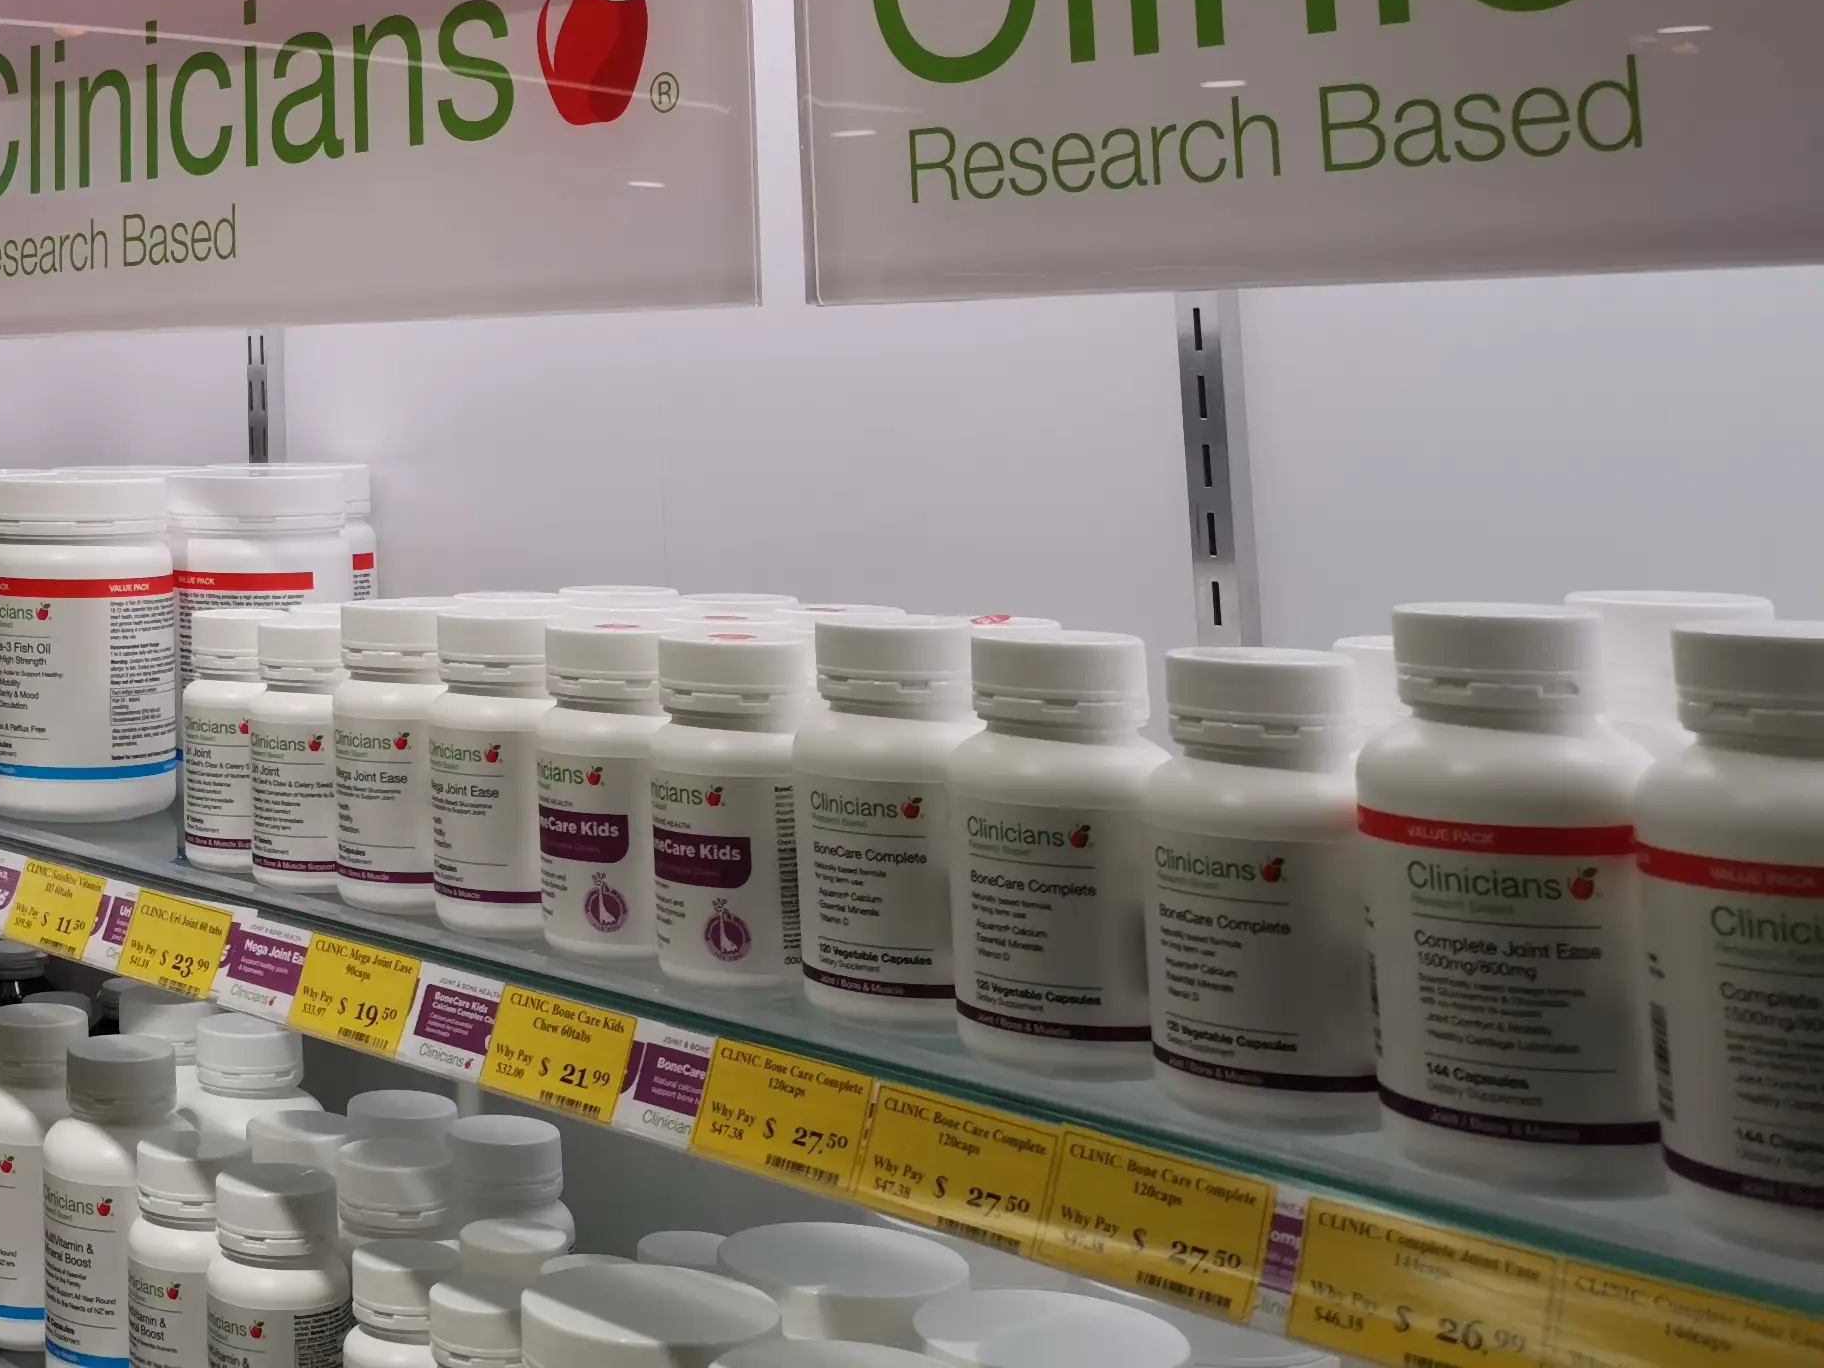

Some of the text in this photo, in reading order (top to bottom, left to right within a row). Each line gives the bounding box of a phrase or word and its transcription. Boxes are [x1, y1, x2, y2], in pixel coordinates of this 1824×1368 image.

[907, 54, 1642, 204] Research Based
[122, 204, 236, 267] Based
[110, 583, 149, 592] VALUE PACK
[0, 654, 47, 667] High Strength
[14, 642, 33, 653] Fish
[36, 643, 51, 654] Oil
[251, 732, 306, 752] Clinicians
[334, 728, 391, 750] Clinicians
[193, 747, 211, 759] Joint
[353, 770, 376, 782] Joint
[380, 771, 408, 784] Ease
[811, 790, 898, 819] Clinicians
[967, 815, 1065, 847] Clinicians
[1406, 823, 1494, 846] VALUE PACK
[700, 843, 741, 861] Kids
[813, 840, 927, 866] BoneCare Complete
[1155, 845, 1256, 881] Clinicians
[26, 861, 50, 878] CLINIC.
[283, 861, 306, 870] Muscle
[308, 862, 335, 871] Support
[970, 869, 1096, 897] BoneCare Complete
[1407, 860, 1562, 901] Clinicians
[40, 911, 85, 935] $ 11.50
[140, 904, 168, 922] CLINIC.
[170, 910, 181, 924] Uri
[182, 915, 198, 931] Joint
[199, 921, 209, 932] 60
[131, 939, 157, 957] Why Pay
[315, 939, 413, 975] CLINIC. Mega Joint Ease
[1414, 929, 1602, 961] Complete Joint Ease
[159, 950, 210, 978] $ 23.99
[230, 983, 268, 1005] Clinicians
[303, 985, 333, 1006] Why Pay
[434, 991, 489, 1014] BoneCare Kids
[462, 983, 479, 993] BONE
[479, 987, 501, 999] HEALTH
[337, 997, 397, 1028] $ 19.50
[510, 992, 625, 1033] CLINIC. Bone Care Kids
[533, 1017, 591, 1044] Chew 60tabs
[419, 1043, 464, 1068] Clinicians
[496, 1043, 534, 1067] Why Pay
[663, 1036, 682, 1047] JOINT
[690, 1043, 710, 1054] BONE
[538, 1057, 610, 1090] $ 21.99
[721, 1047, 863, 1096] CLINIC. Bone Care Complete
[1425, 1061, 1529, 1090] 144 Capsules
[712, 1101, 756, 1126] Why Pay
[884, 1096, 1047, 1156] CLINIC. Bone Care Complete
[709, 1121, 744, 1141] $47.38
[762, 1117, 848, 1156] $ 27.50
[937, 1132, 981, 1156] 120caps
[874, 1154, 926, 1183] Why Pay
[1069, 1142, 1258, 1207] CLINIC. Bone Care Complete
[873, 1176, 911, 1200] $47.38
[933, 1175, 1029, 1217] $ 27.50
[1133, 1181, 1183, 1207] 120caps
[1061, 1204, 1121, 1239] Why Pay
[1132, 1227, 1242, 1274] $ 27.50
[140, 1326, 165, 1341] Boost
[160, 1318, 166, 1328] &
[1395, 1305, 1528, 1356] $ 26.99
